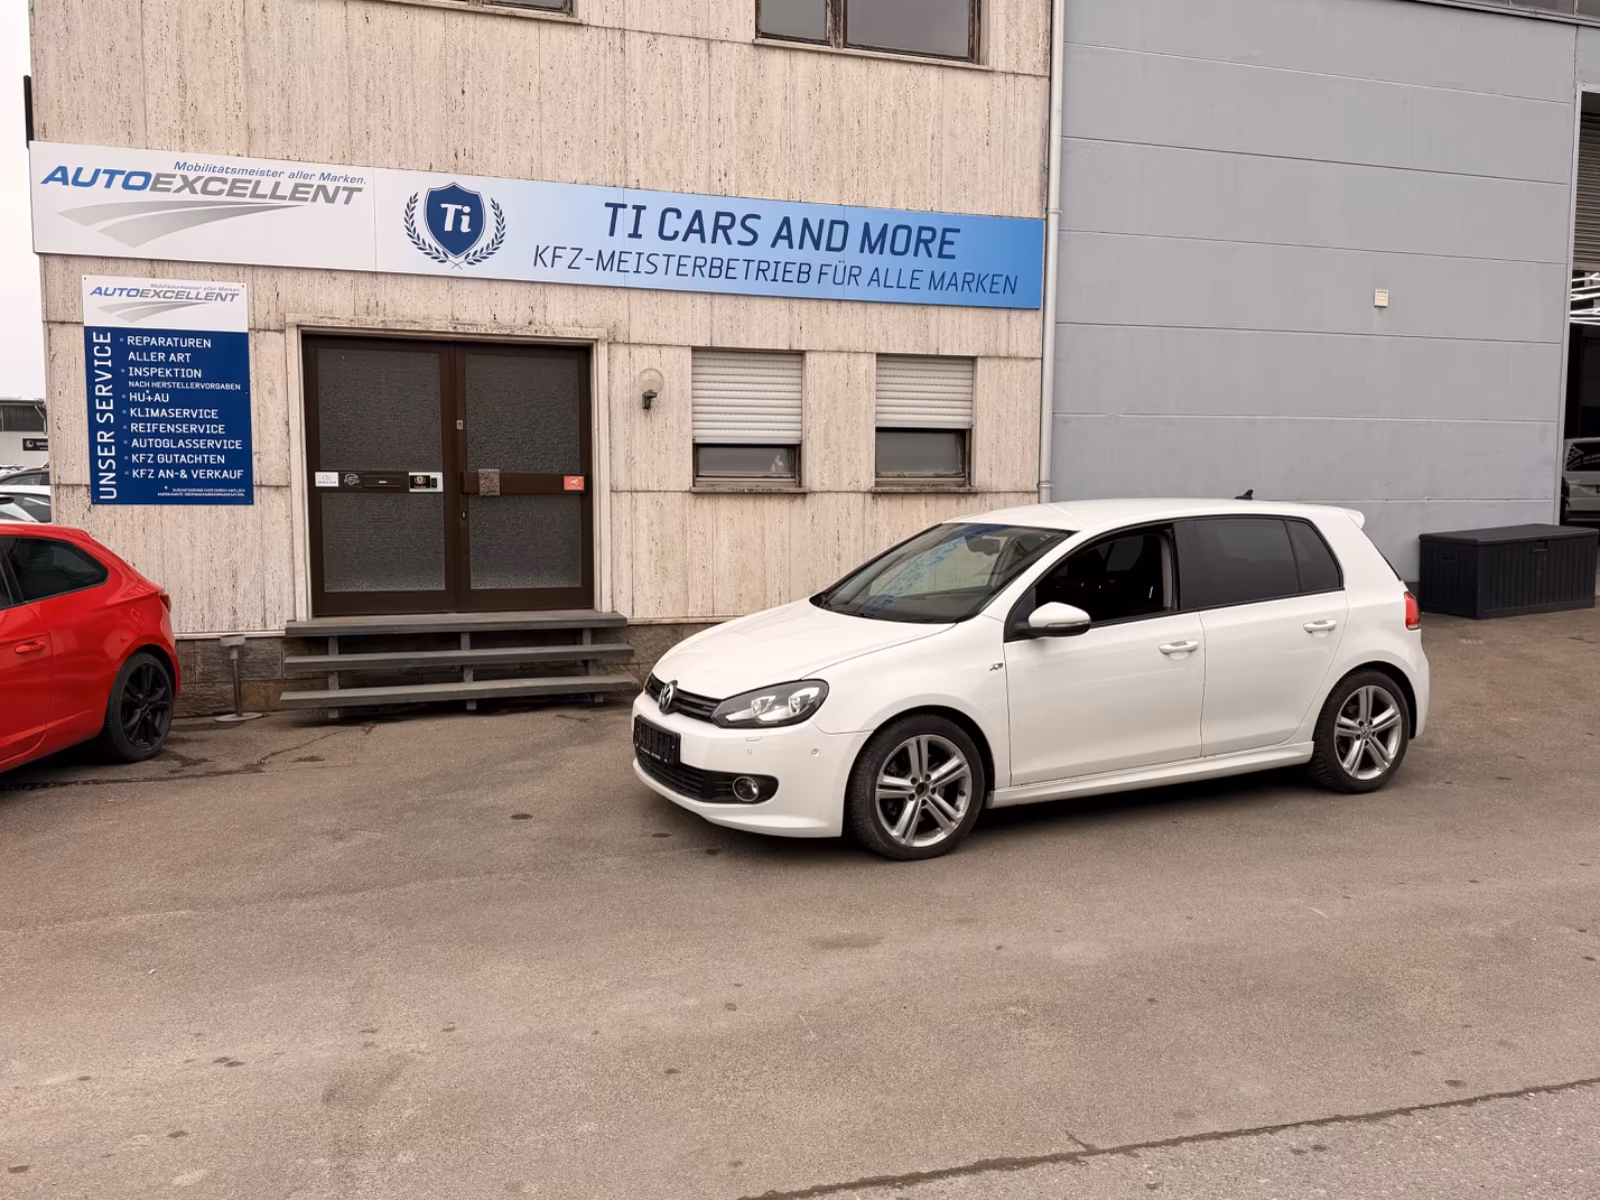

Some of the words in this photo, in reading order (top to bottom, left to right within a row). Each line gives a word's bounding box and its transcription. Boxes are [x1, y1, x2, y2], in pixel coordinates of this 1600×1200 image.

[173, 160, 285, 179] Mobilitätsmeister
[288, 169, 315, 181] aller
[319, 171, 366, 185] Marken.
[440, 203, 472, 233] Ti
[604, 202, 647, 239] TI
[657, 207, 761, 247] CARS
[770, 215, 849, 252] AND
[859, 222, 961, 260] MORE
[533, 245, 812, 284] KFZ-MEISTERBETRIEB
[817, 260, 862, 286] FÜR
[867, 267, 921, 290] ALLE
[928, 271, 1018, 296] MARKEN
[127, 336, 211, 348] REPARATUREN
[128, 352, 165, 362] ALLER
[169, 353, 191, 363] ART
[93, 331, 114, 423] SERVICE
[128, 366, 202, 378] INSPEKTION
[151, 381, 241, 390] HERSTELLERVORGABEN
[130, 408, 219, 419] KLIMASERVICE
[131, 423, 225, 434] REIFENSERVICE
[131, 438, 242, 450] AUTOGLASSERVICE
[131, 453, 154, 463] KFZ
[157, 454, 225, 464] GUTACHTEN
[97, 430, 117, 500] UNSER
[132, 469, 155, 479] KFZ
[191, 469, 244, 479] VERKAUF
